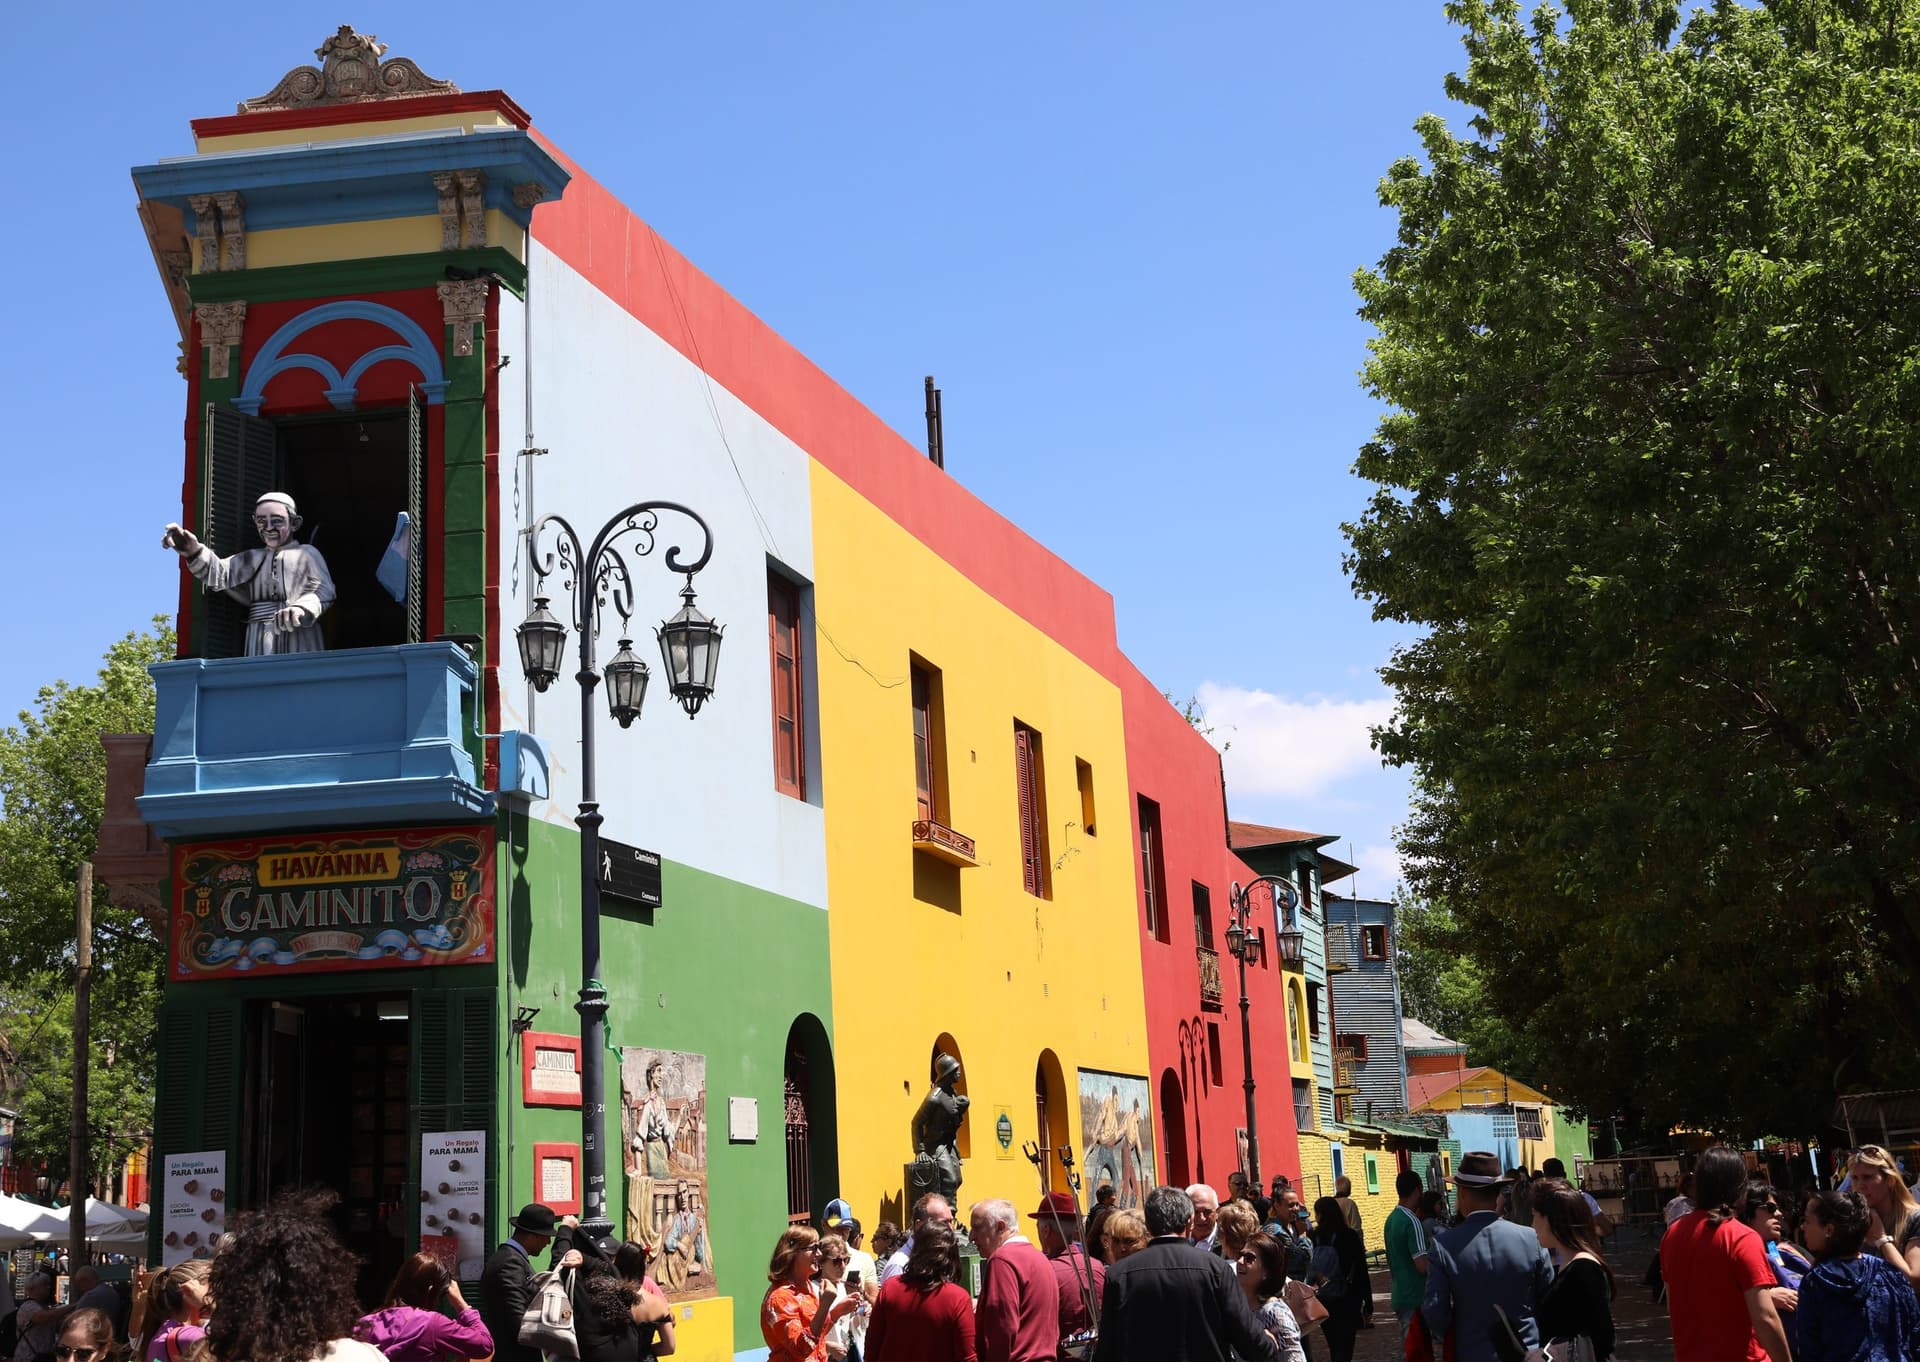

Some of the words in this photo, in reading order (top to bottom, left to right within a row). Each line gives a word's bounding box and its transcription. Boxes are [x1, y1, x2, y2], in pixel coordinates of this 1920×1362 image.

[336, 63, 361, 81] 1891
[270, 852, 388, 880] HAVANNA
[634, 850, 659, 866] Caminito
[454, 884, 465, 898] H
[220, 876, 442, 933] CAMINITO
[536, 1051, 574, 1070] CAMINITO
[456, 1139, 479, 1147] Regalo
[194, 1165, 219, 1175] MAMÁ
